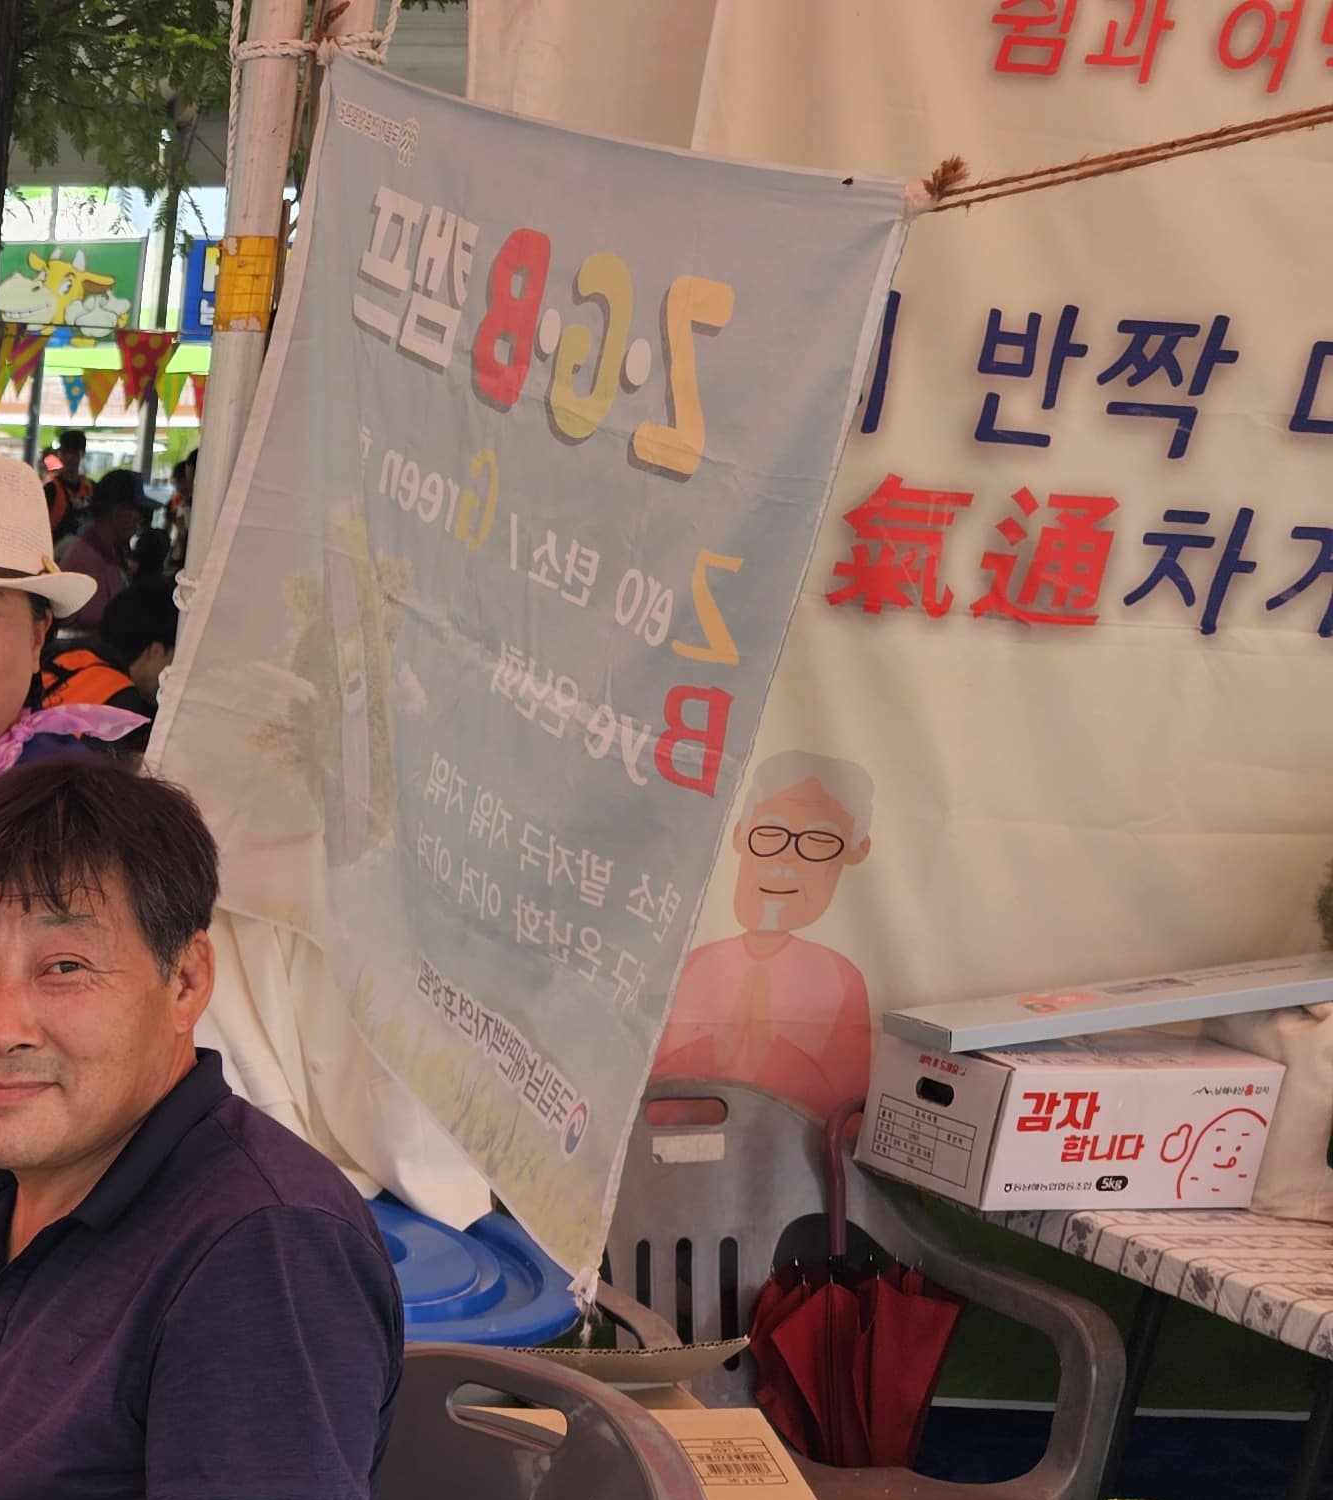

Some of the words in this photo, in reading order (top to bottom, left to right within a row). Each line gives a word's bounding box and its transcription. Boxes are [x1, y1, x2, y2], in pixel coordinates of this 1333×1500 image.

[1217, 0, 1333, 93] 여
[974, 303, 1240, 460] 반짝
[1016, 1091, 1101, 1132] 감자
[1060, 1134, 1146, 1163] 합니다
[1100, 1177, 1124, 1191] 5kg
